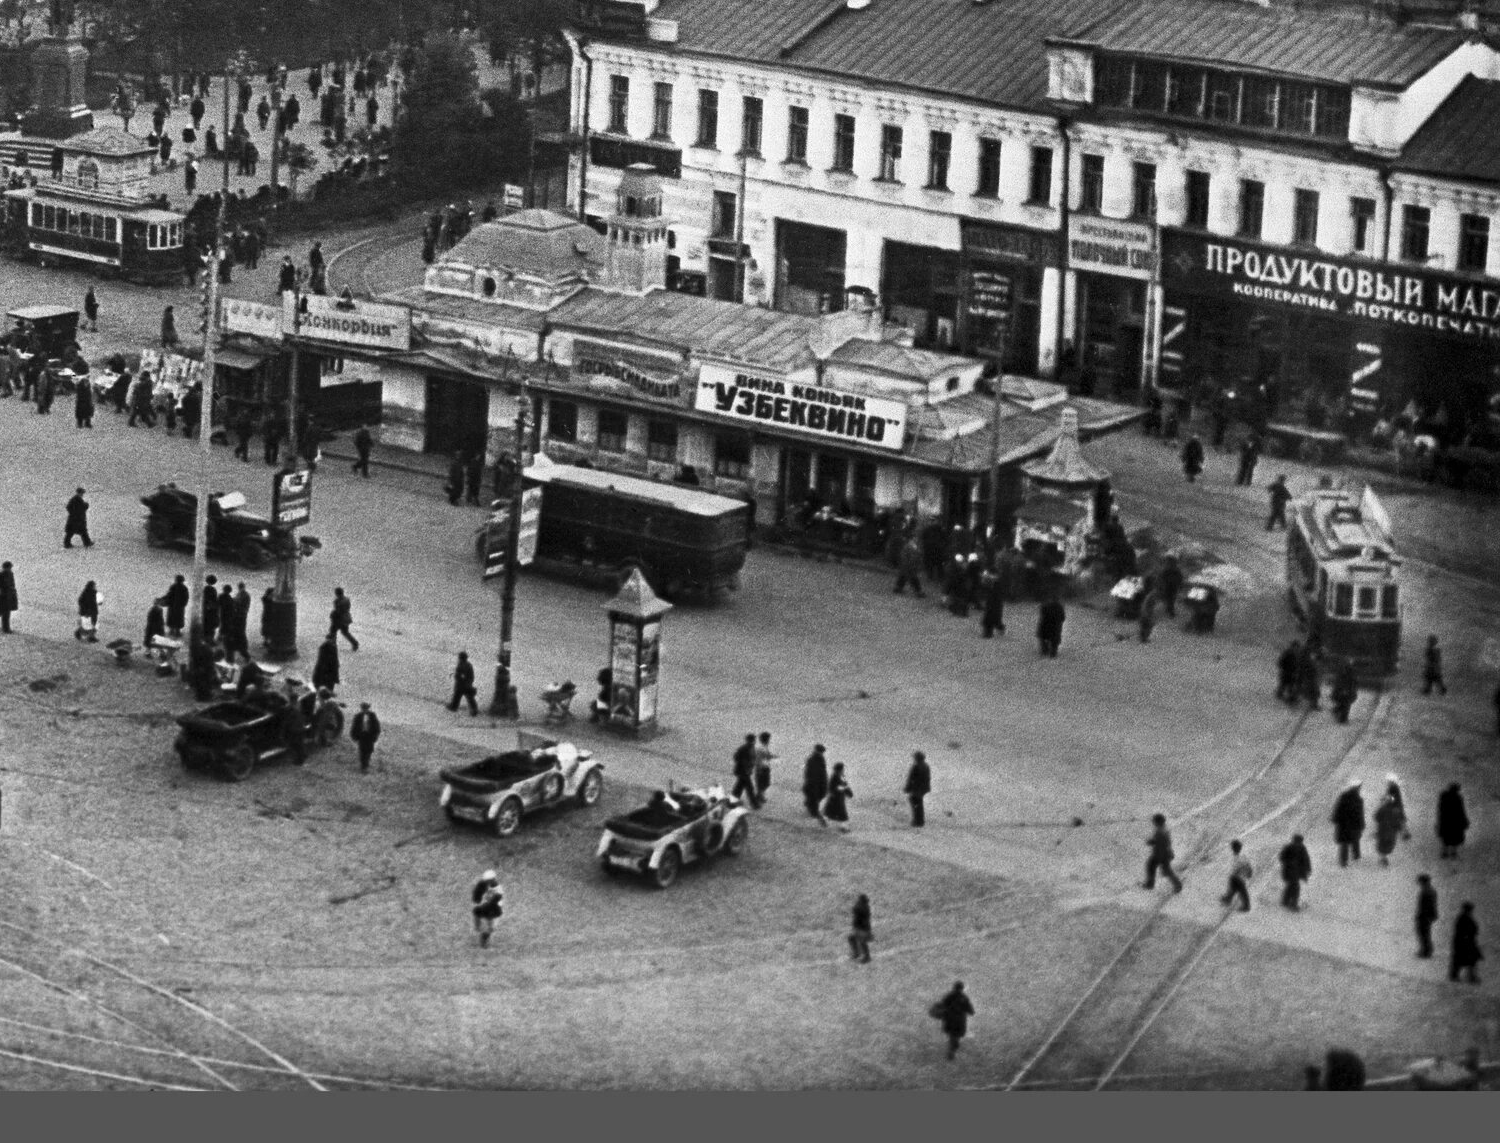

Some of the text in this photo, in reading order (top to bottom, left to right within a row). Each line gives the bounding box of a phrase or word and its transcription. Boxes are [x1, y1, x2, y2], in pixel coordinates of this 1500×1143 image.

[1206, 244, 1423, 307] ПРОДУКТОВЫЙ
[1233, 282, 1338, 311] КООПЕРАТИВА
[701, 381, 900, 442] "УЗБЕКВИНО"
[735, 373, 866, 411] ВИНА КОНЬЯК
